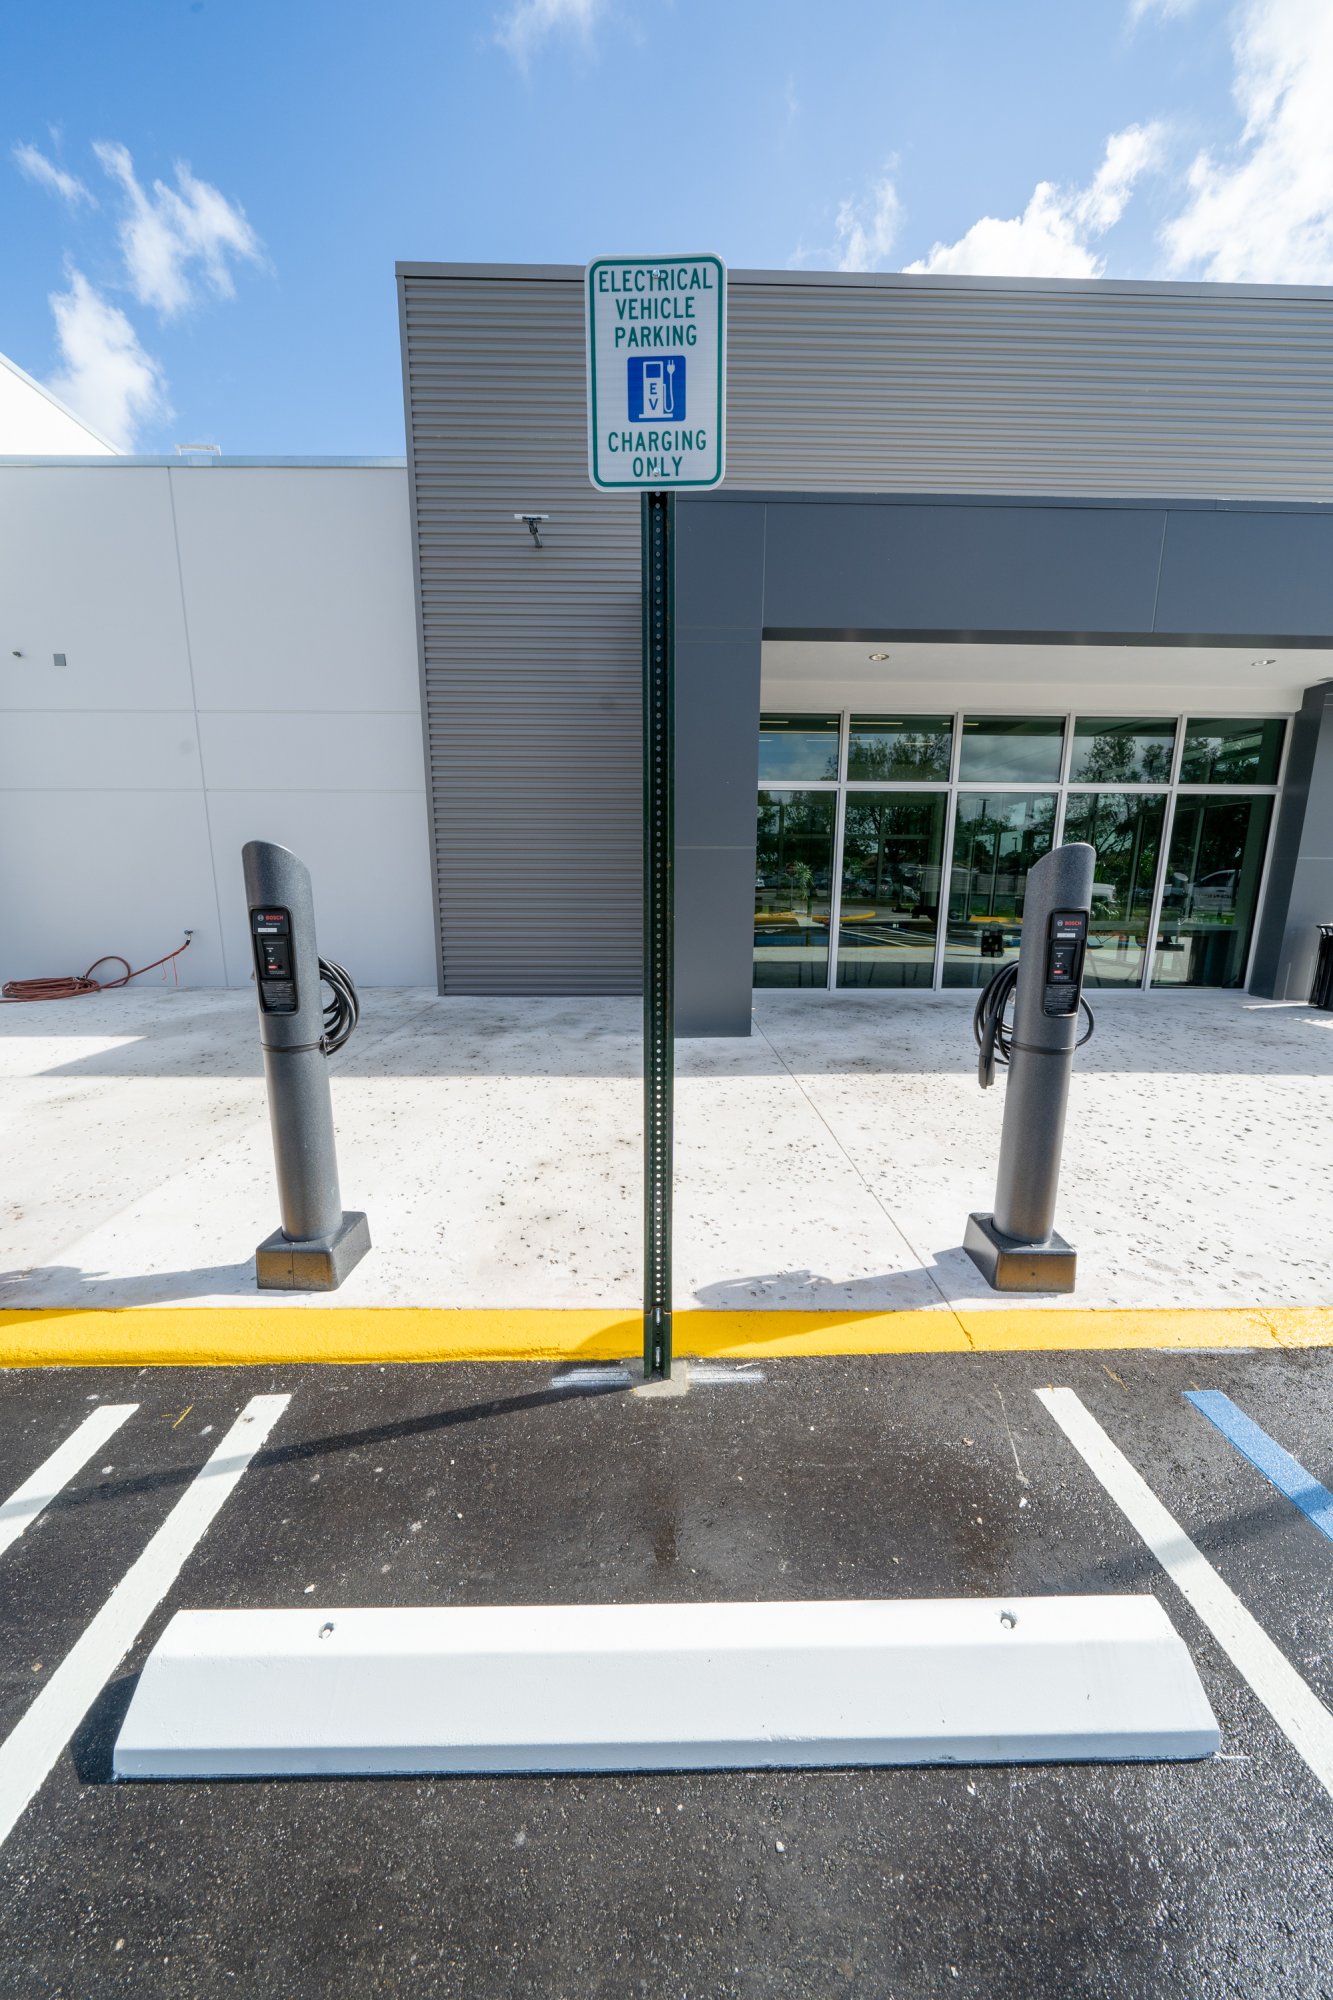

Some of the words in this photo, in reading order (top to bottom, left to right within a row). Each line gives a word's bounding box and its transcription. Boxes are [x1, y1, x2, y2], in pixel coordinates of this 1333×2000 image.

[599, 267, 713, 292] ELECTRICAL
[615, 297, 695, 320] VEHICLE
[615, 325, 697, 348] PARKING
[608, 430, 706, 452] CHARGING
[632, 456, 683, 477] ONLY
